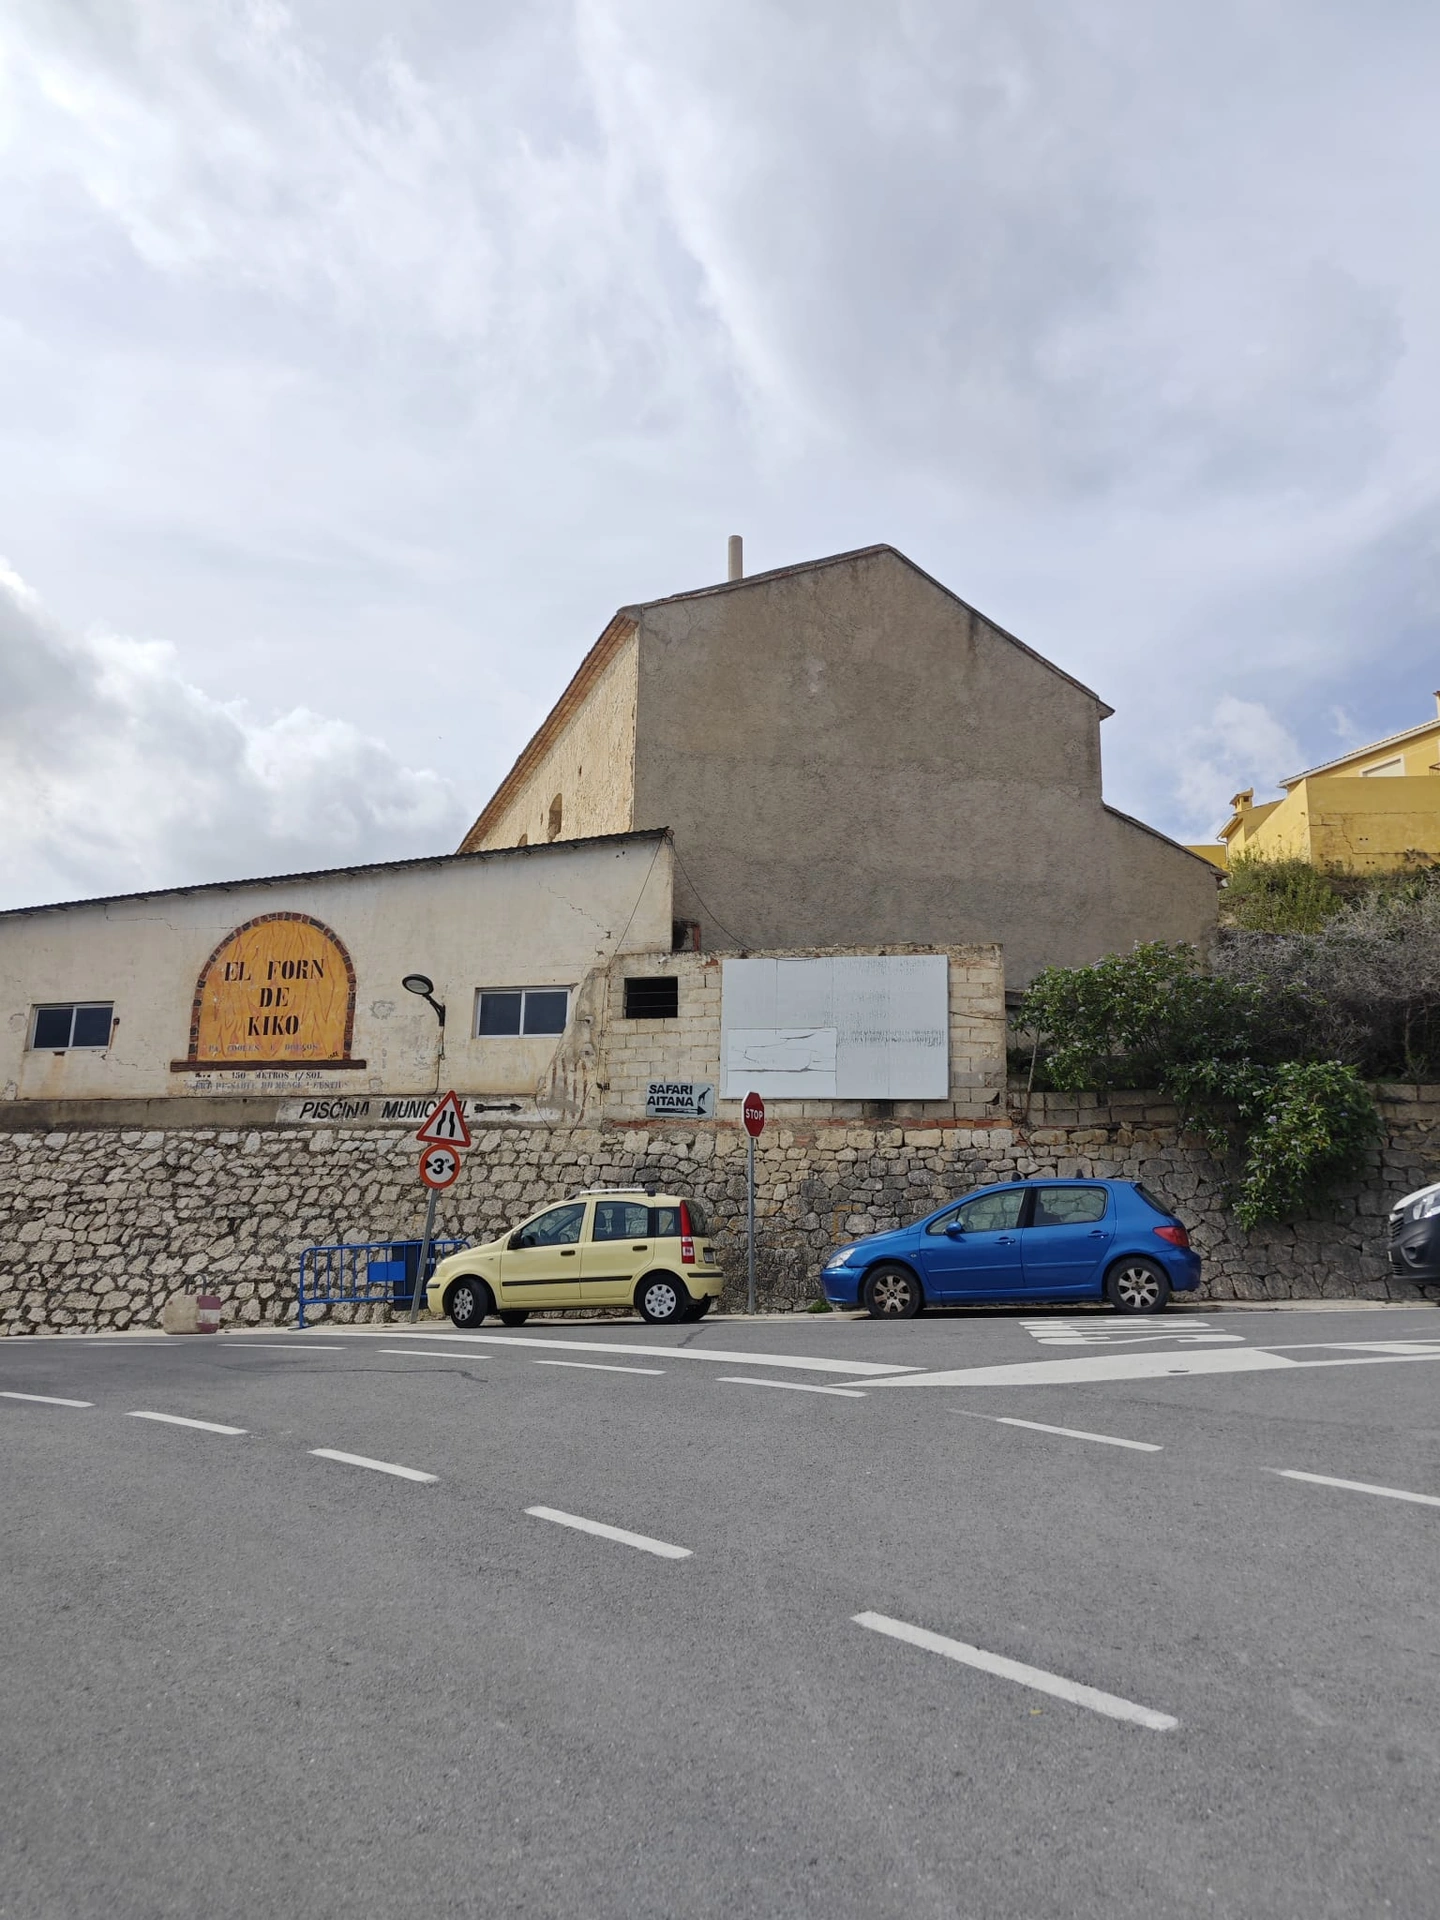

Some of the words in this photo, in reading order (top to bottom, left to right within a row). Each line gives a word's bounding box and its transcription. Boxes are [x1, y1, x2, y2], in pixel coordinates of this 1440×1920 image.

[224, 961, 251, 982] EL
[267, 958, 325, 981] FORN
[259, 987, 290, 1008] DE
[247, 1014, 299, 1037] KIKO
[232, 1071, 246, 1079] 150
[255, 1071, 290, 1080] METROS
[648, 1084, 693, 1095] SAFARI
[647, 1095, 694, 1107] AITANA
[299, 1100, 370, 1119] PISCINA
[381, 1100, 470, 1119] MUNICL
[745, 1108, 763, 1120] STOP
